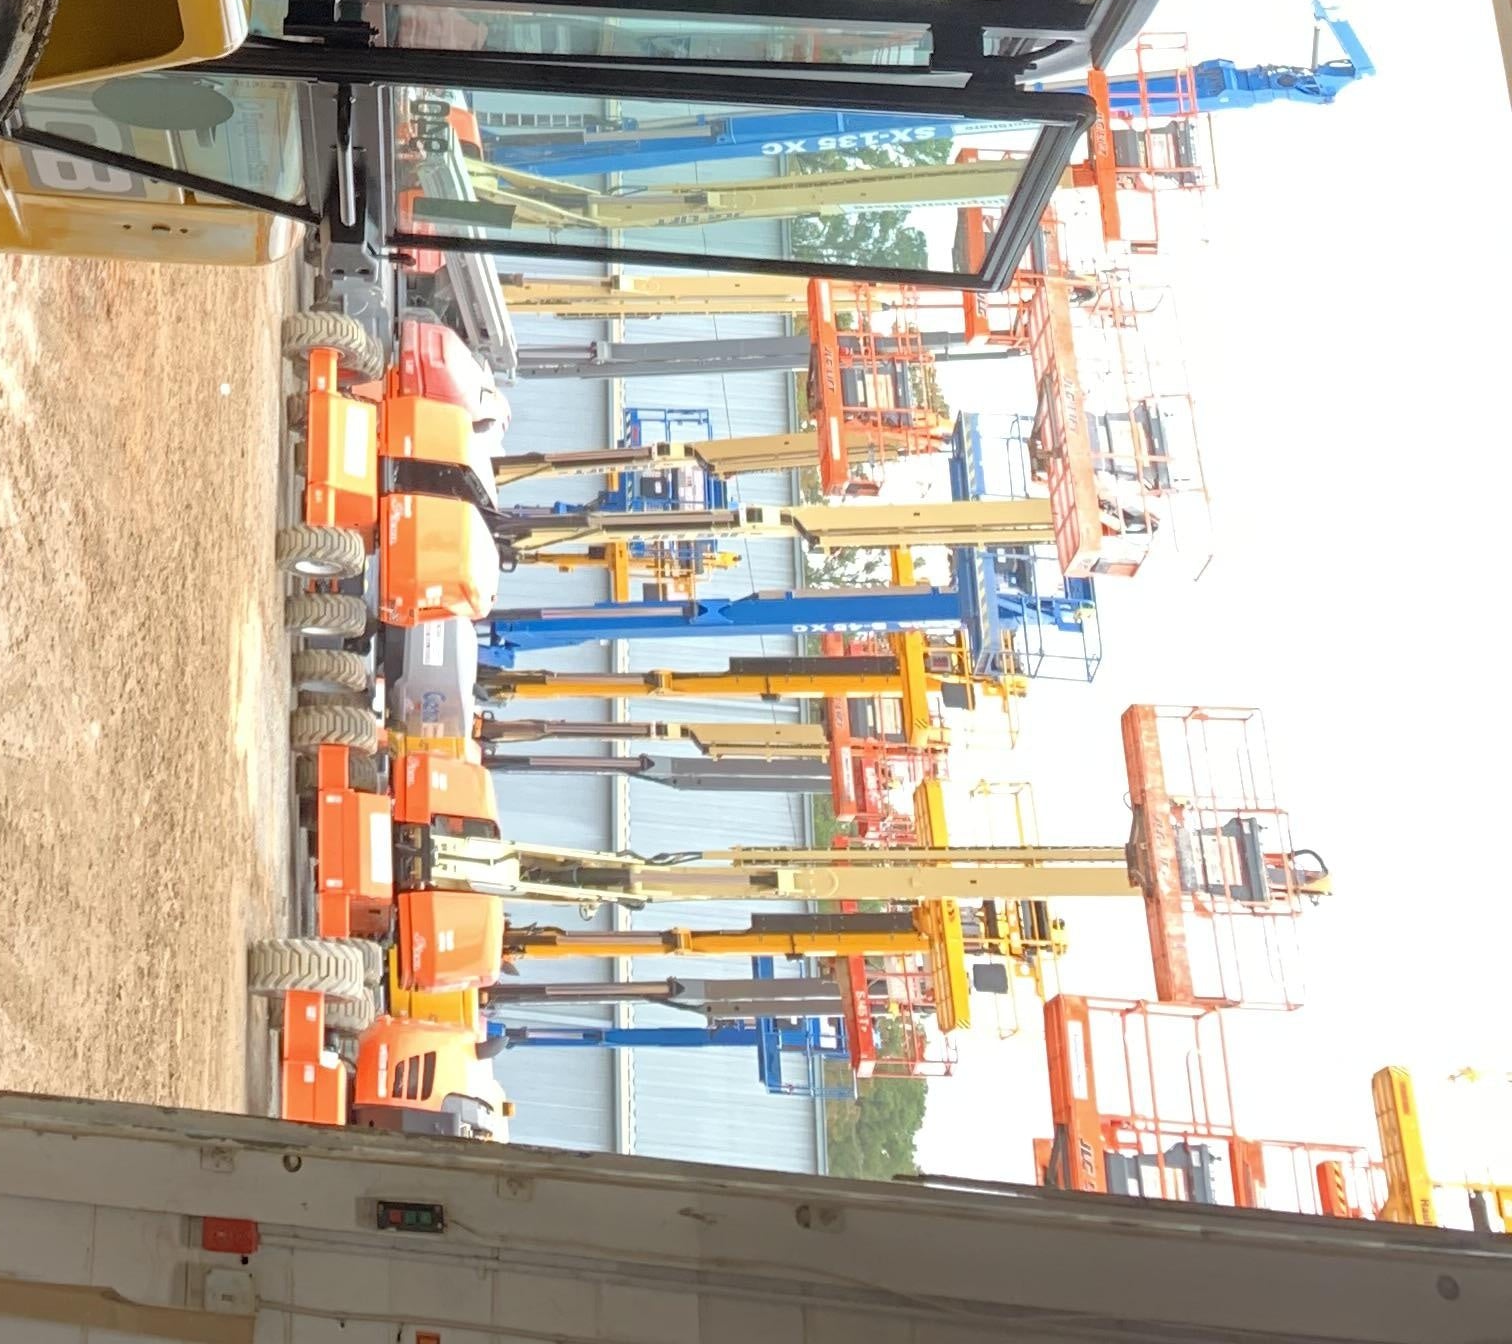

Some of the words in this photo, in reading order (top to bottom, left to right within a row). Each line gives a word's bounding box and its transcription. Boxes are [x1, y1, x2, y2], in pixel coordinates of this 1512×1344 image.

[760, 138, 807, 156] XC
[817, 126, 936, 150] SX-135
[825, 369, 835, 393] LIFT
[1079, 1138, 1094, 1175] JLG
